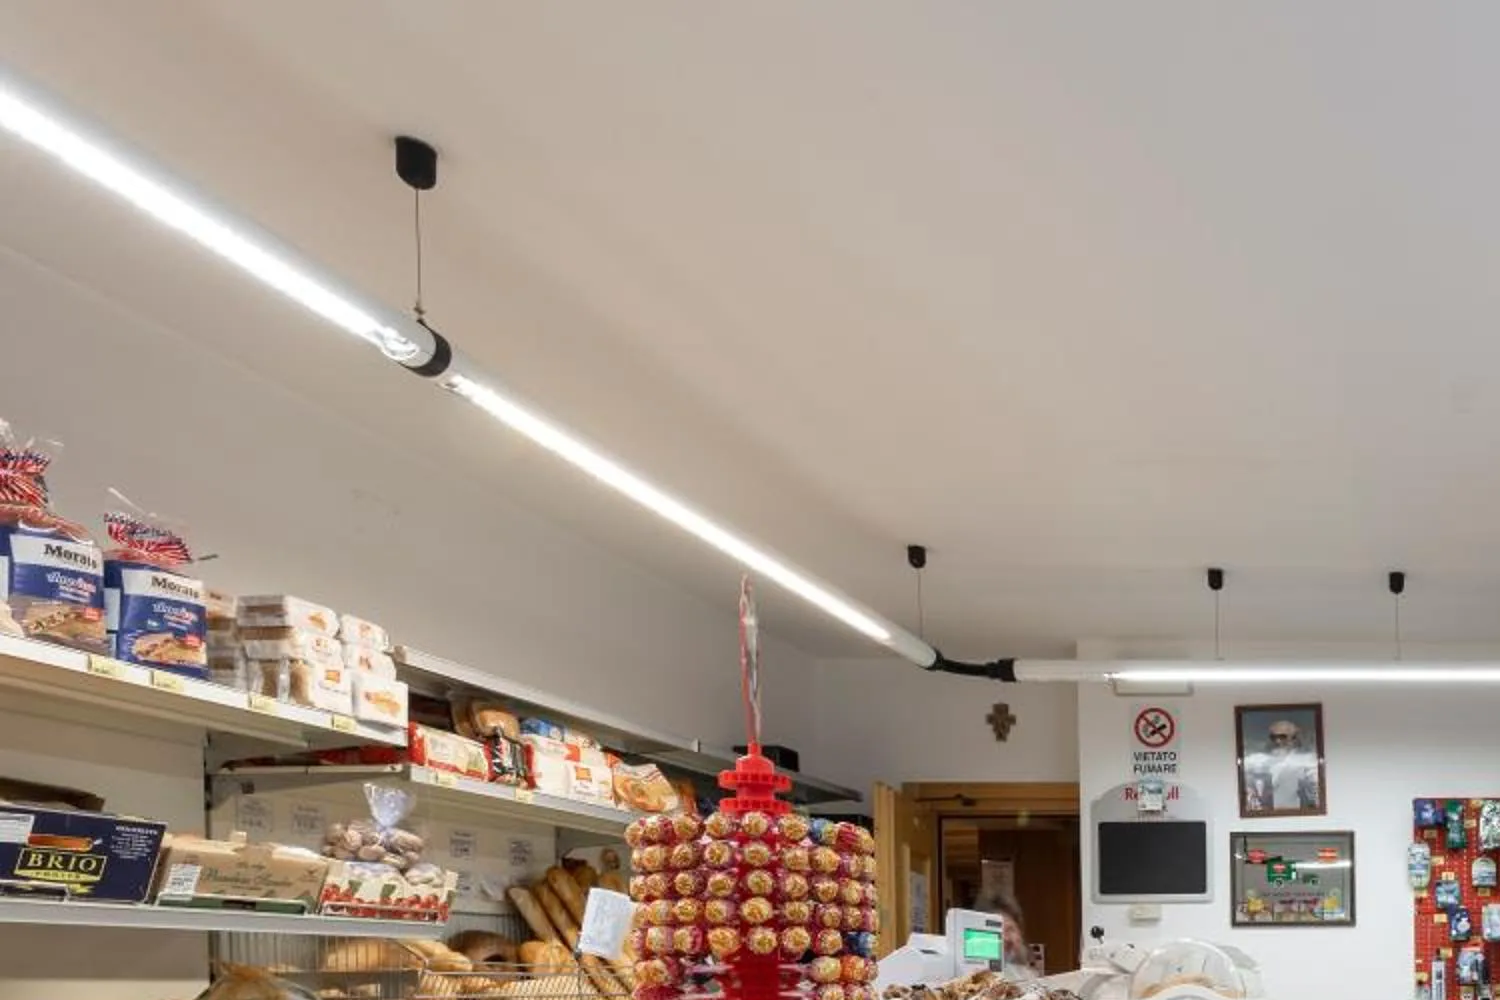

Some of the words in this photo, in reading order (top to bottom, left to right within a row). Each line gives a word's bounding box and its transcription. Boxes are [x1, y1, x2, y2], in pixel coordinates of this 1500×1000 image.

[1133, 751, 1177, 762] VIETATO
[1133, 763, 1177, 774] FUMARE
[1125, 787, 1139, 801] Re
[27, 852, 98, 873] BRIO
